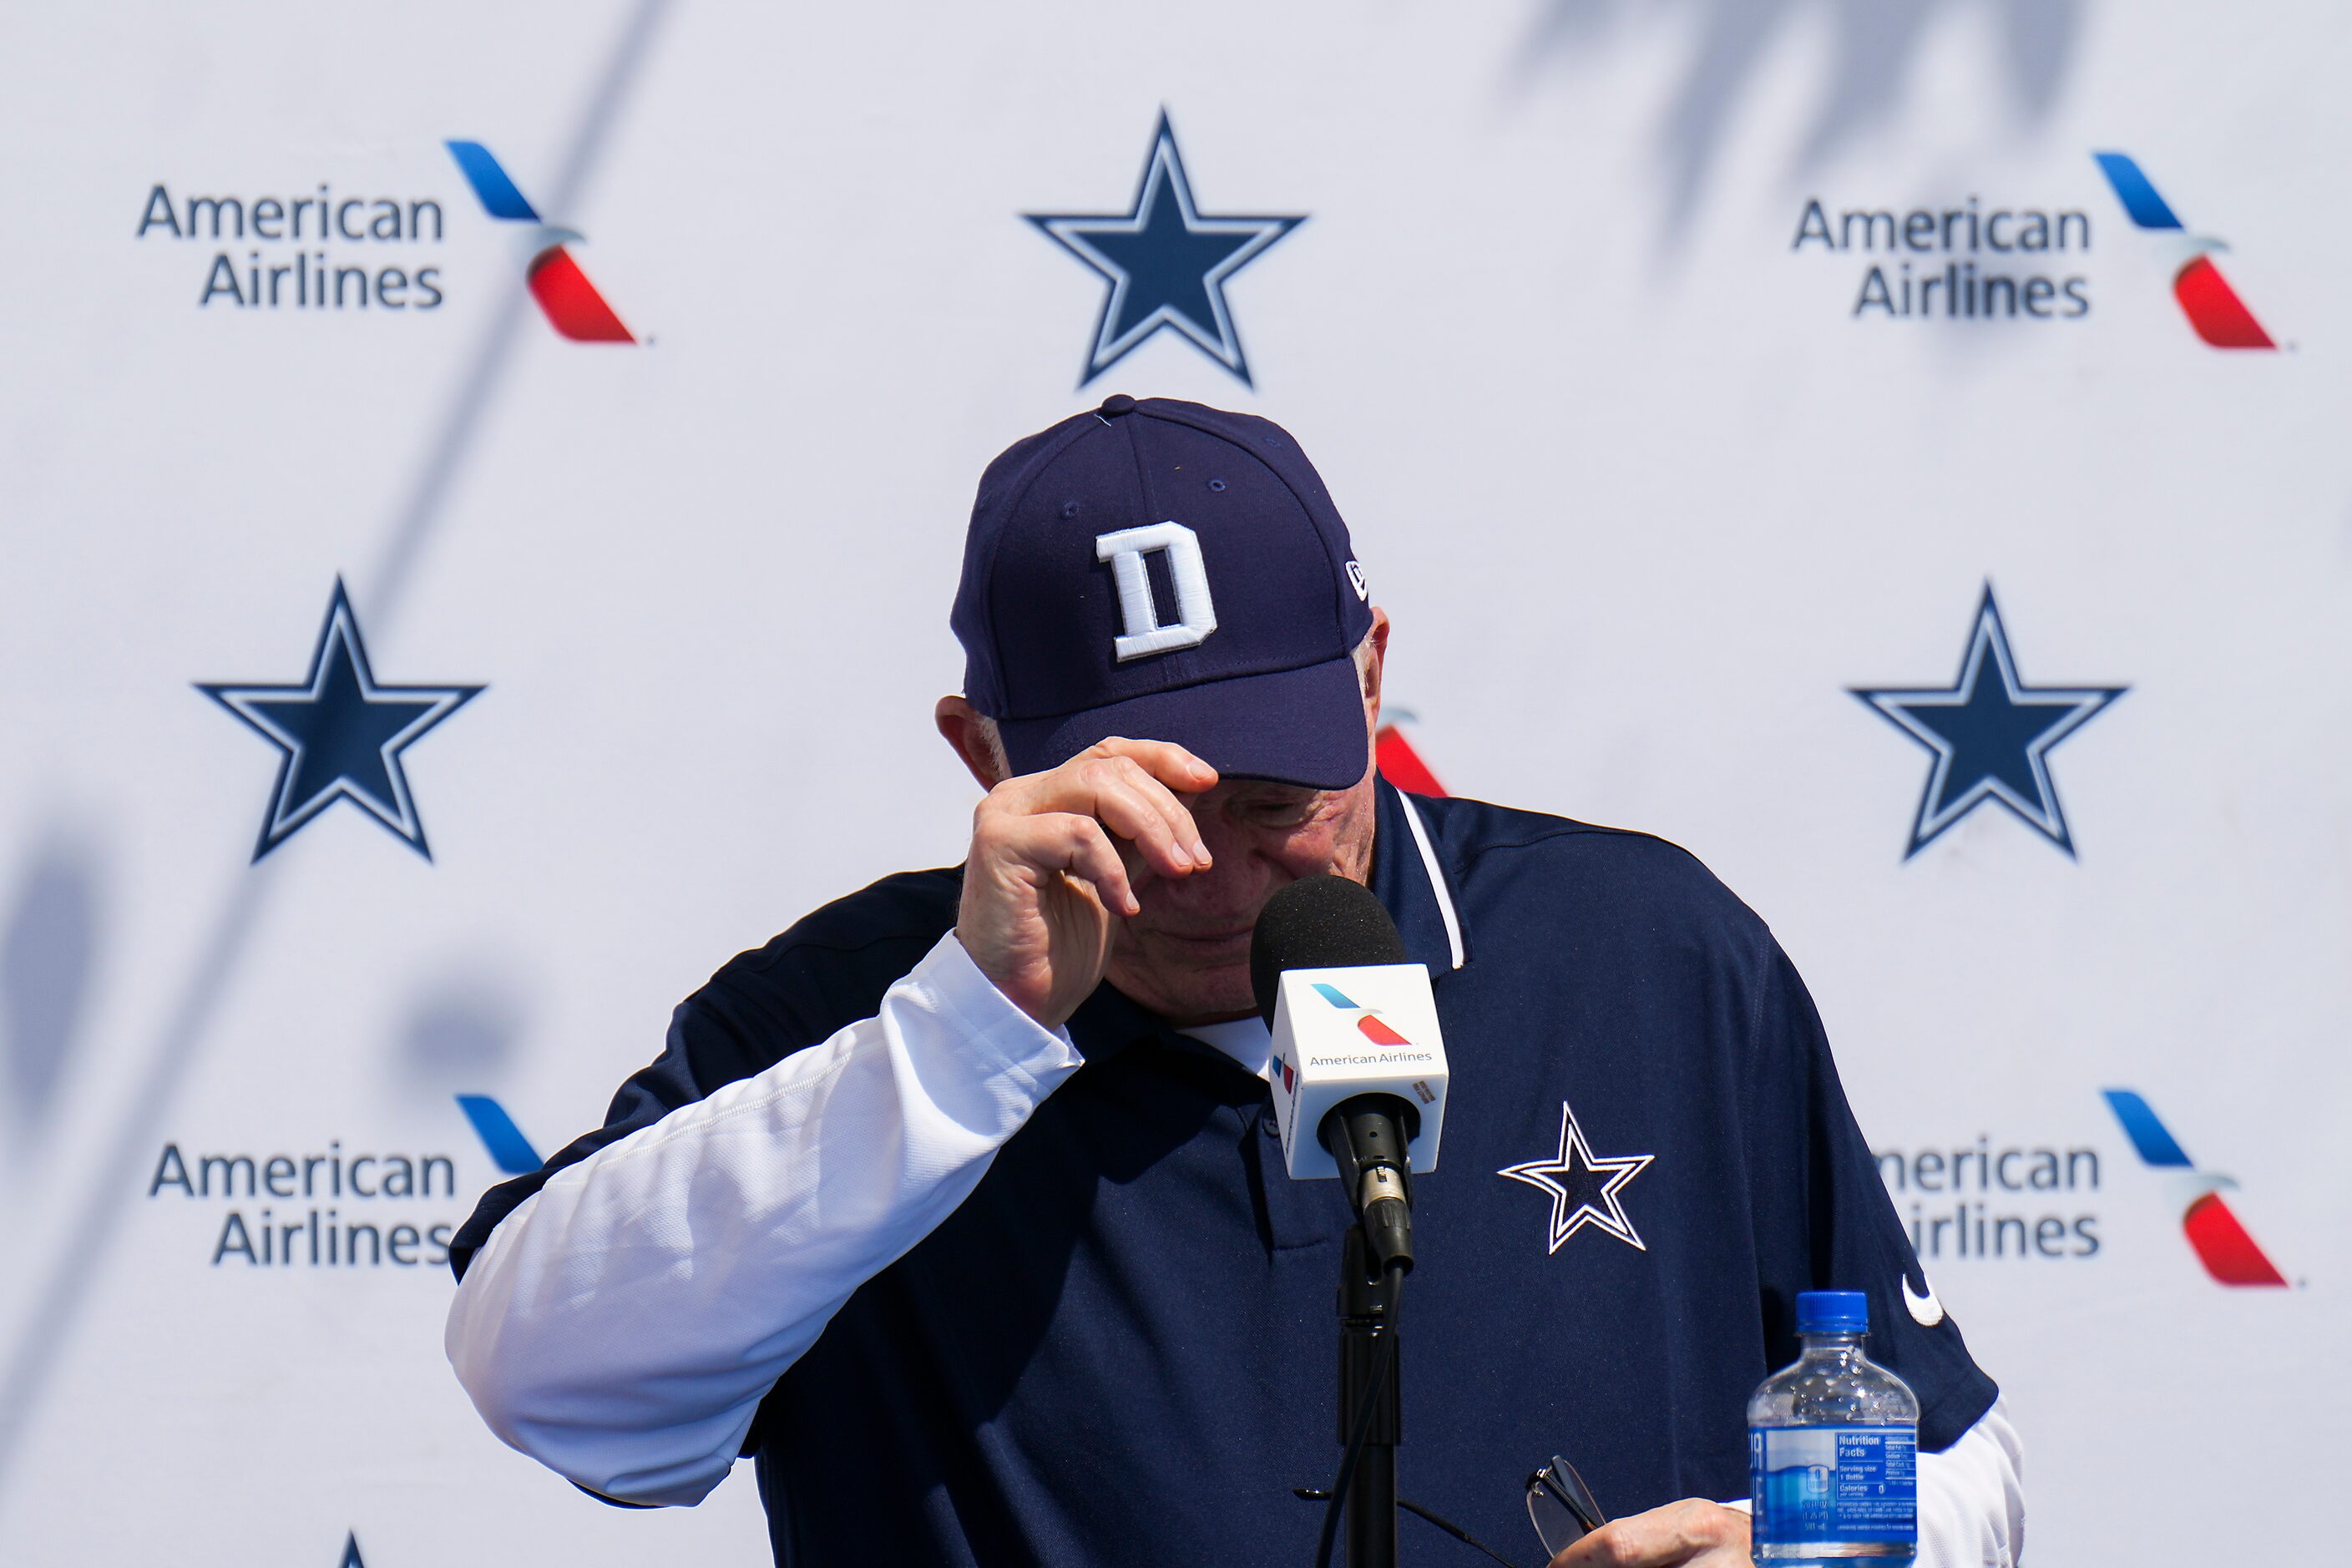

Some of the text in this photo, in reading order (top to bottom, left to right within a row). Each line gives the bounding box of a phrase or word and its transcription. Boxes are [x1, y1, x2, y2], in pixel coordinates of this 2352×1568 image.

[137, 185, 443, 240] American
[1793, 200, 2088, 253] American
[200, 252, 443, 309] Airlines
[1853, 261, 2087, 318] Airlines
[1095, 521, 1217, 663] D
[1310, 1052, 1433, 1066] American Airlines
[149, 1142, 455, 1197] American
[1871, 1136, 2098, 1191] merican
[213, 1210, 449, 1266] Airlines
[1913, 1205, 2099, 1257] irlines
[1839, 1435, 1879, 1445] Nutrition
[1839, 1448, 1865, 1457] Facts
[1879, 1485, 1884, 1495] 0
